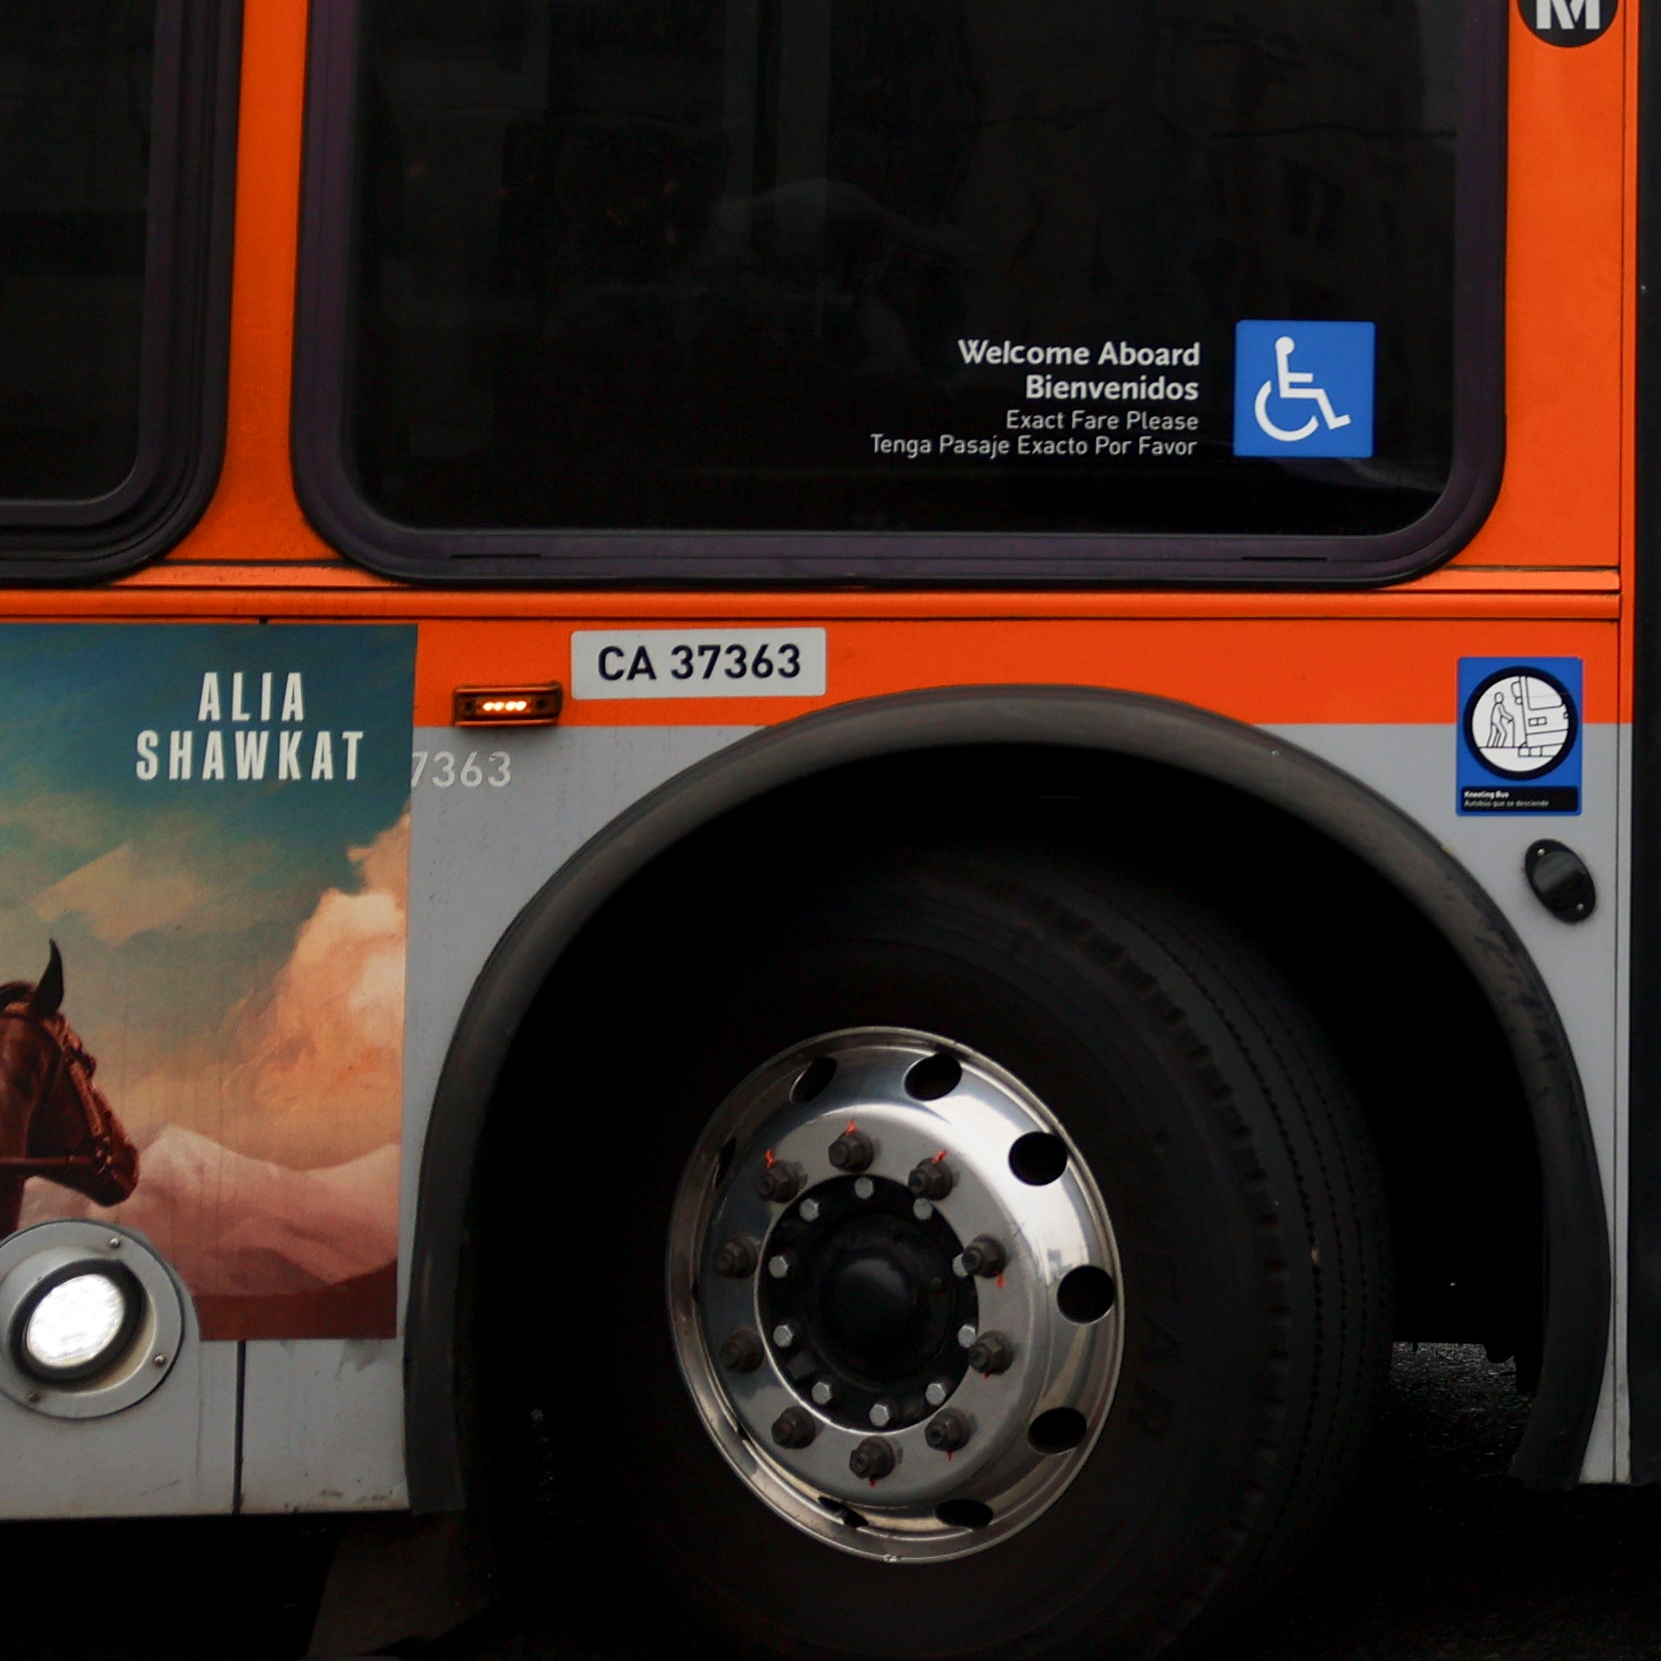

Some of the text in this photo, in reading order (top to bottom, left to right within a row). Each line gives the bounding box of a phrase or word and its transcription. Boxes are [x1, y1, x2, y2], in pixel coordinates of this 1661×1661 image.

[958, 339, 1201, 367] Welcome Aboard
[1026, 374, 1200, 401] Bienvenidos
[1007, 410, 1200, 432] Exact Fare Please
[870, 434, 1198, 460] Tenga Pasaje Exacto Por Favor
[598, 642, 801, 681] CA 37363
[198, 671, 305, 723] ALIA
[135, 729, 364, 782] SHAWKAT
